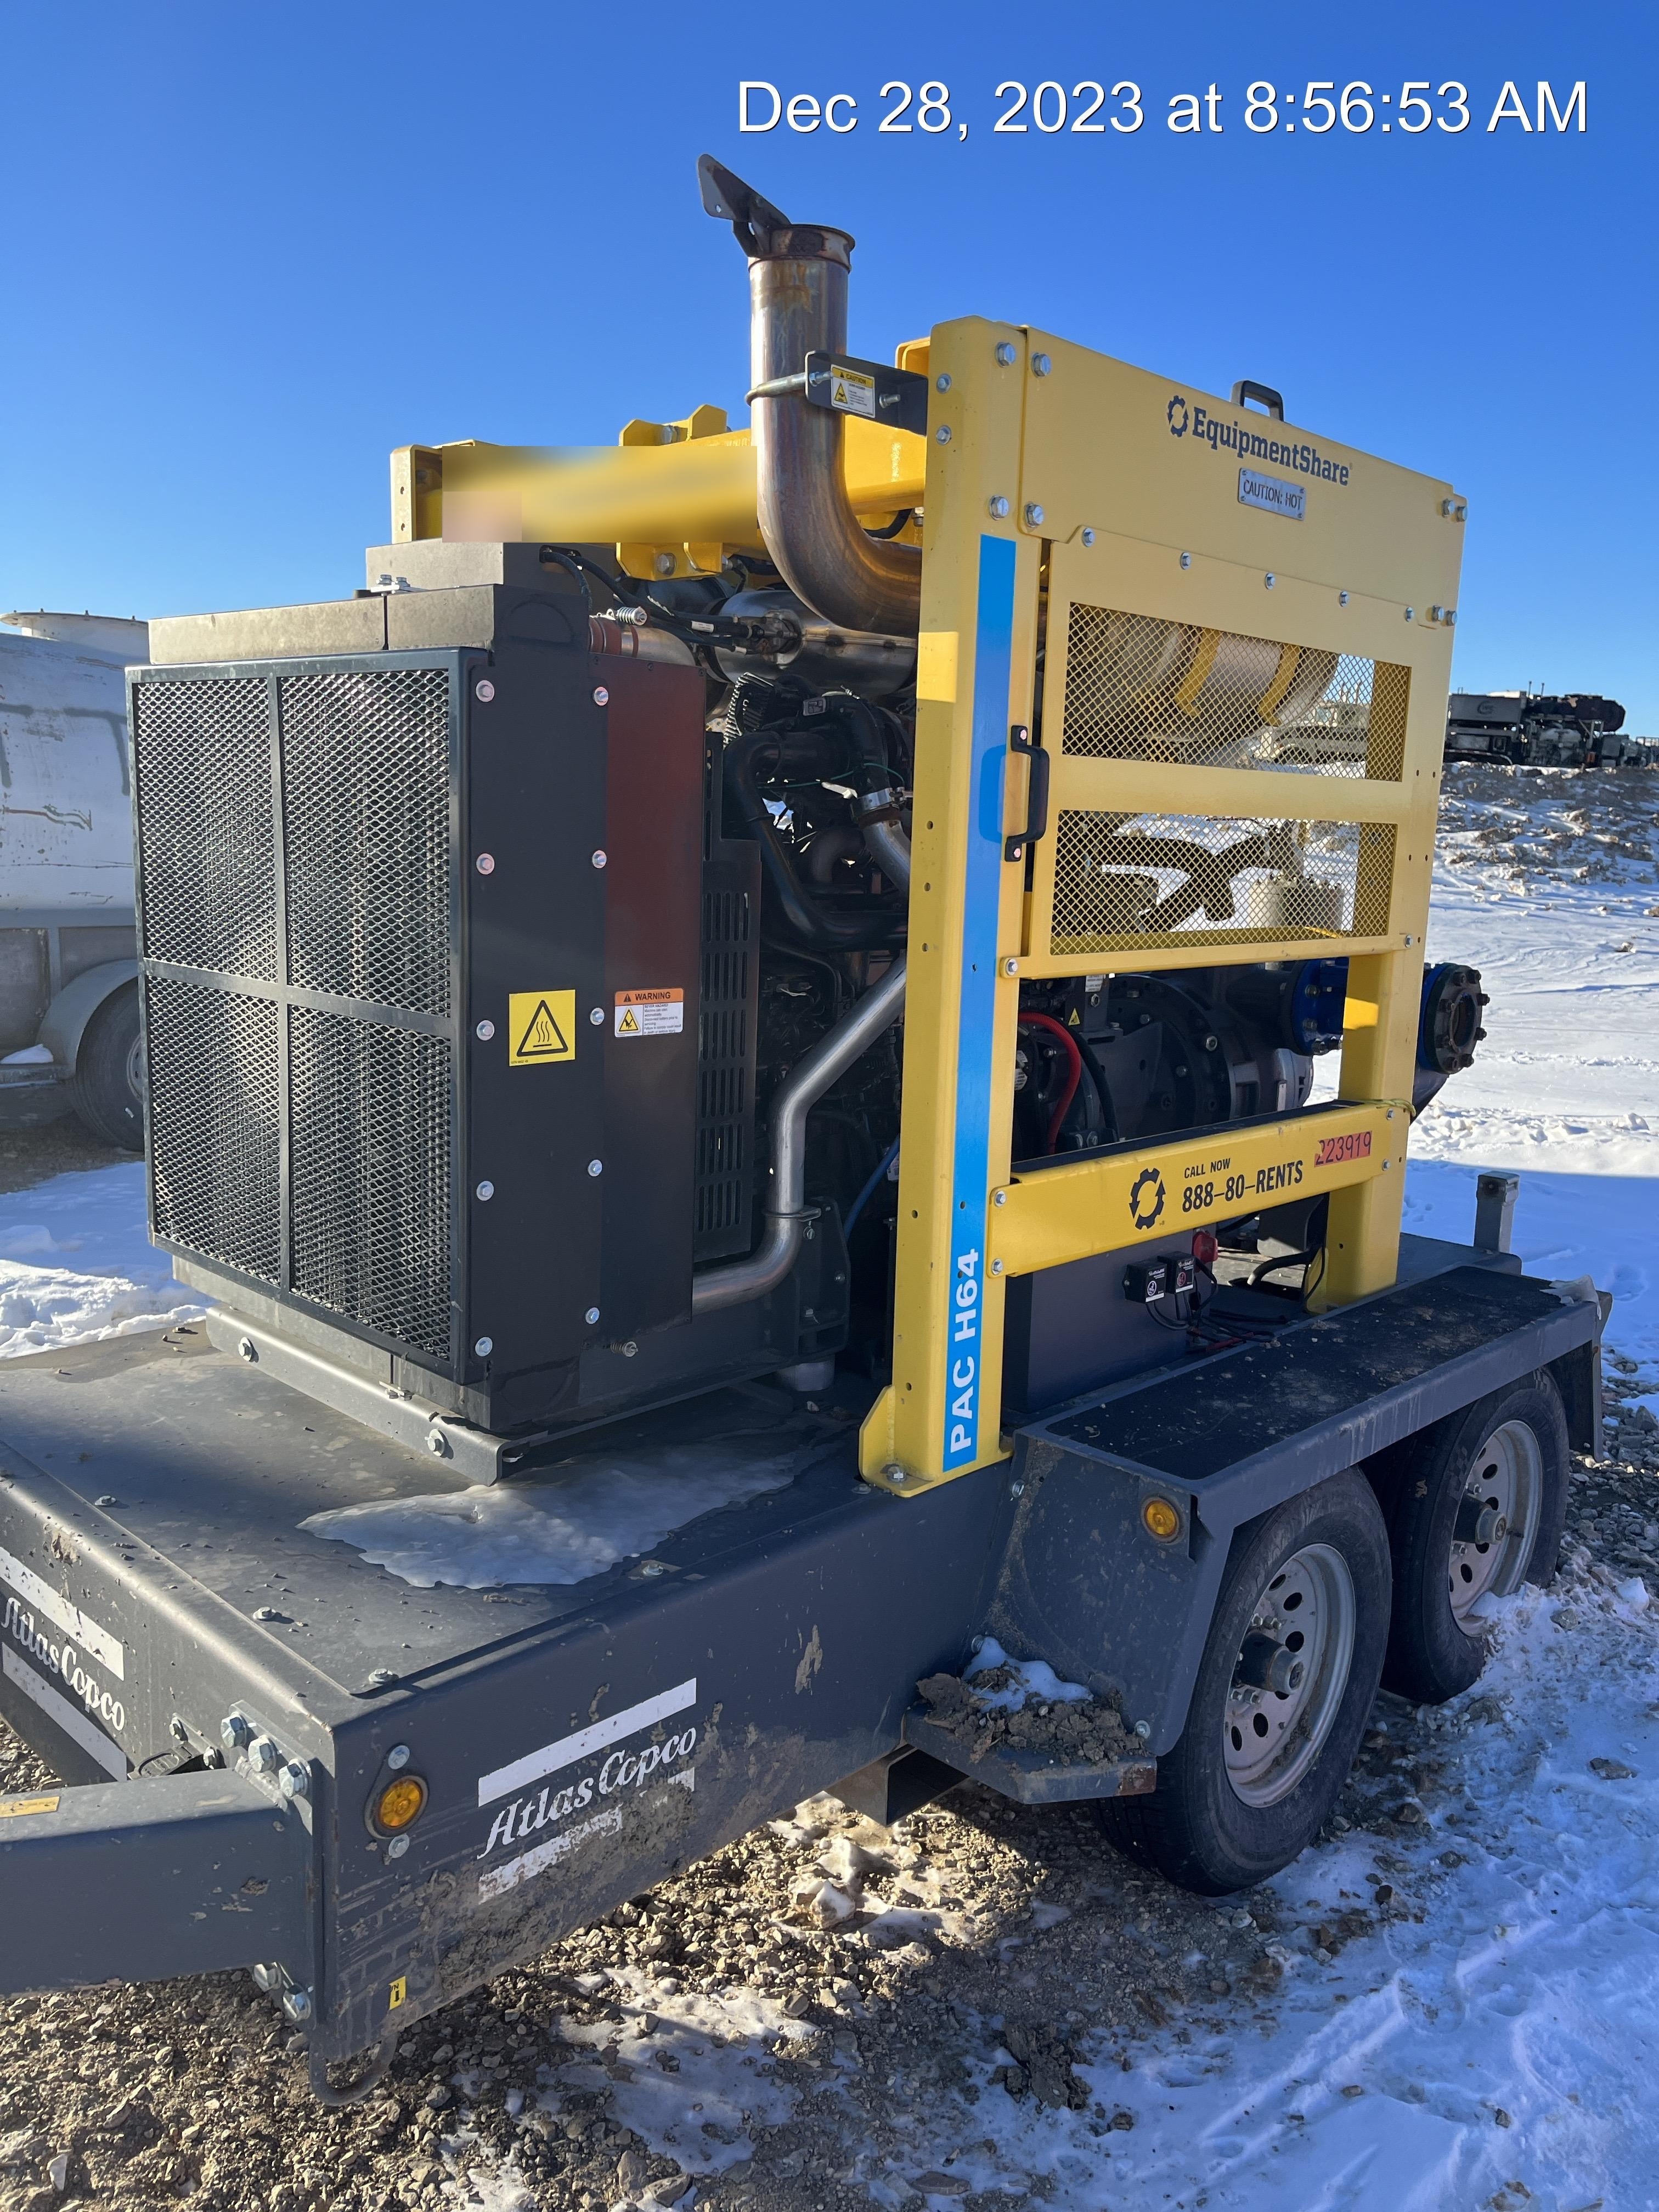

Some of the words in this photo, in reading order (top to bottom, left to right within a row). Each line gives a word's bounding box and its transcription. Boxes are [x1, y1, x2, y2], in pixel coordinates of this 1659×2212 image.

[1192, 407, 1349, 486] EquipmentShare
[1243, 479, 1283, 505] CAUTION:
[1285, 492, 1303, 510] HOT
[635, 991, 670, 1001] WARNING
[1184, 1164, 1206, 1179] CALL
[1210, 1157, 1231, 1173] NOW
[1316, 1131, 1372, 1165] 223919
[1182, 1160, 1303, 1212] 888-80-RENTS
[954, 1248, 979, 1342] H64
[951, 1355, 975, 1453] PAC
